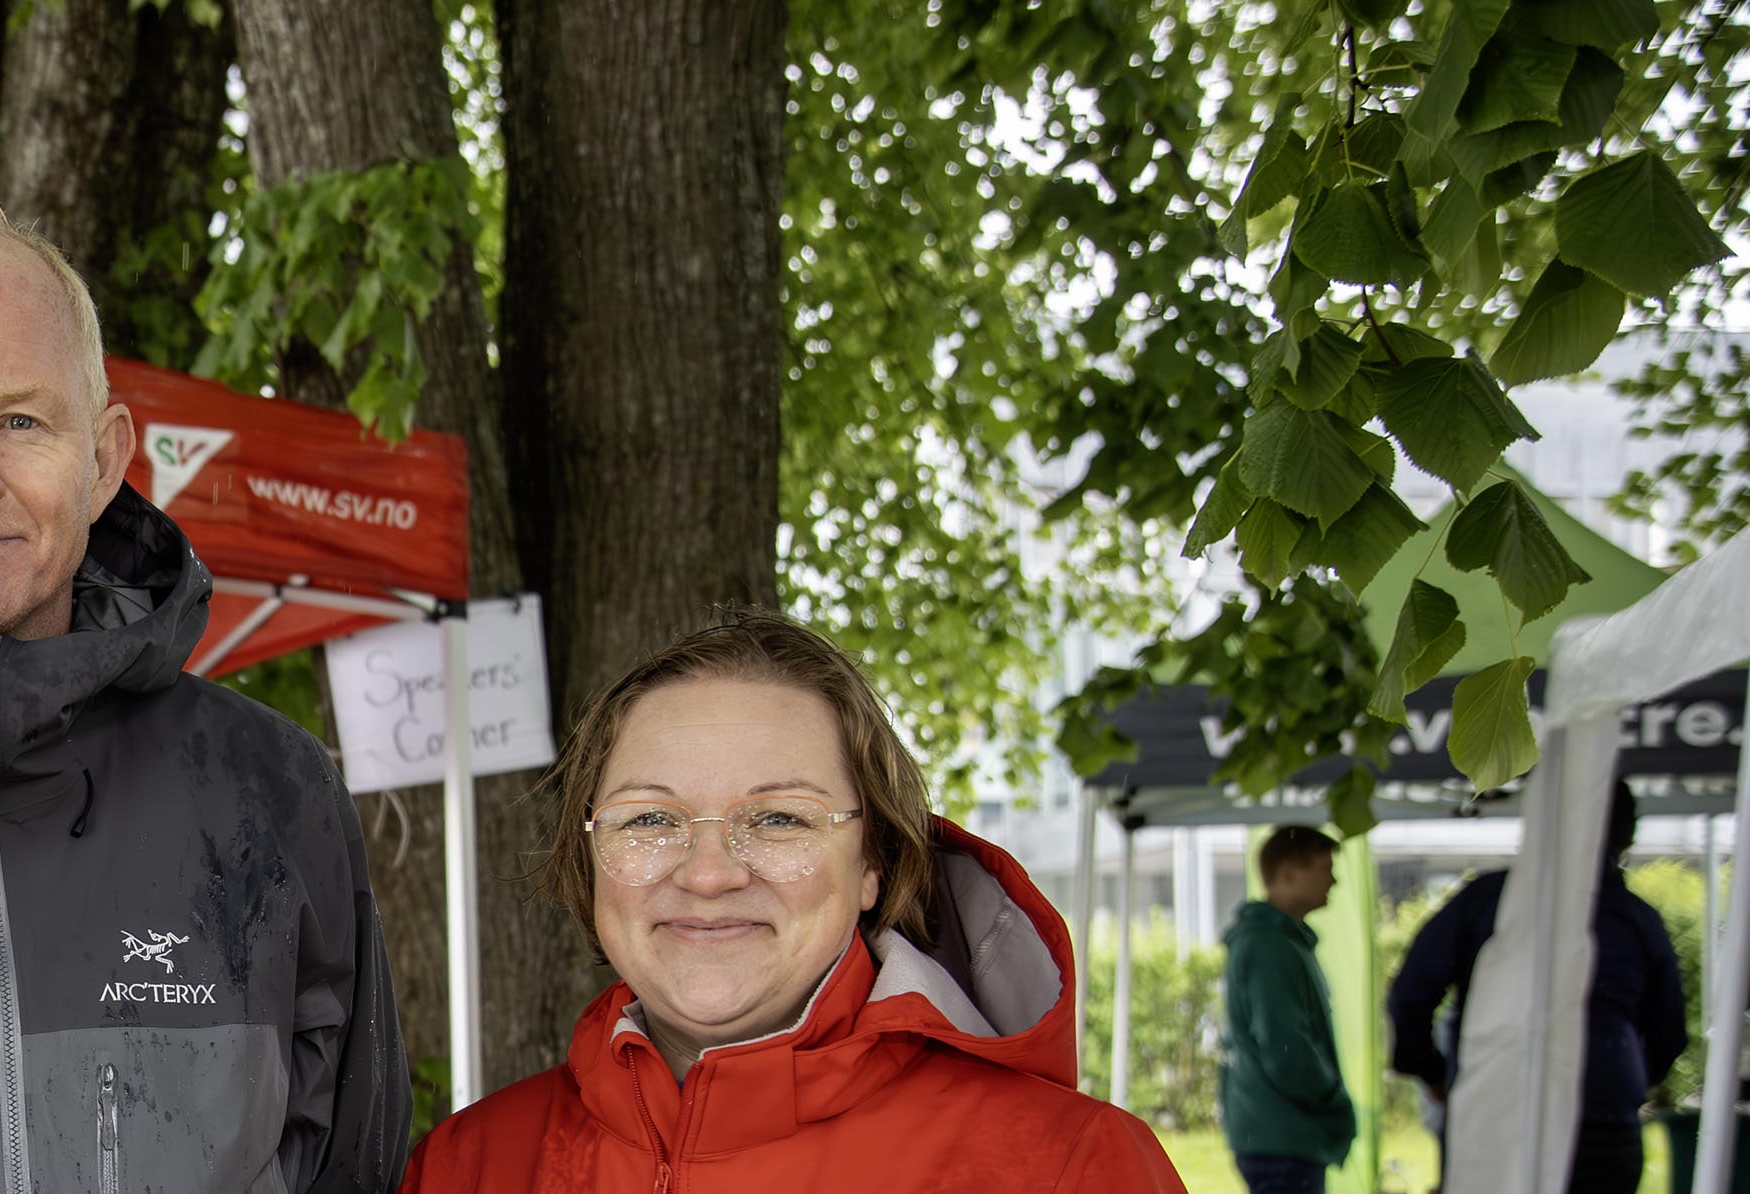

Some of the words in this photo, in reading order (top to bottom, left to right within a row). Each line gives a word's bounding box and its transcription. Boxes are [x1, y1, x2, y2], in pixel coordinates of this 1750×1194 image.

[155, 436, 207, 466] SV
[246, 474, 417, 530] www.sv.no
[363, 647, 522, 713] Speers'
[99, 981, 217, 1005] ARC'TERYX
